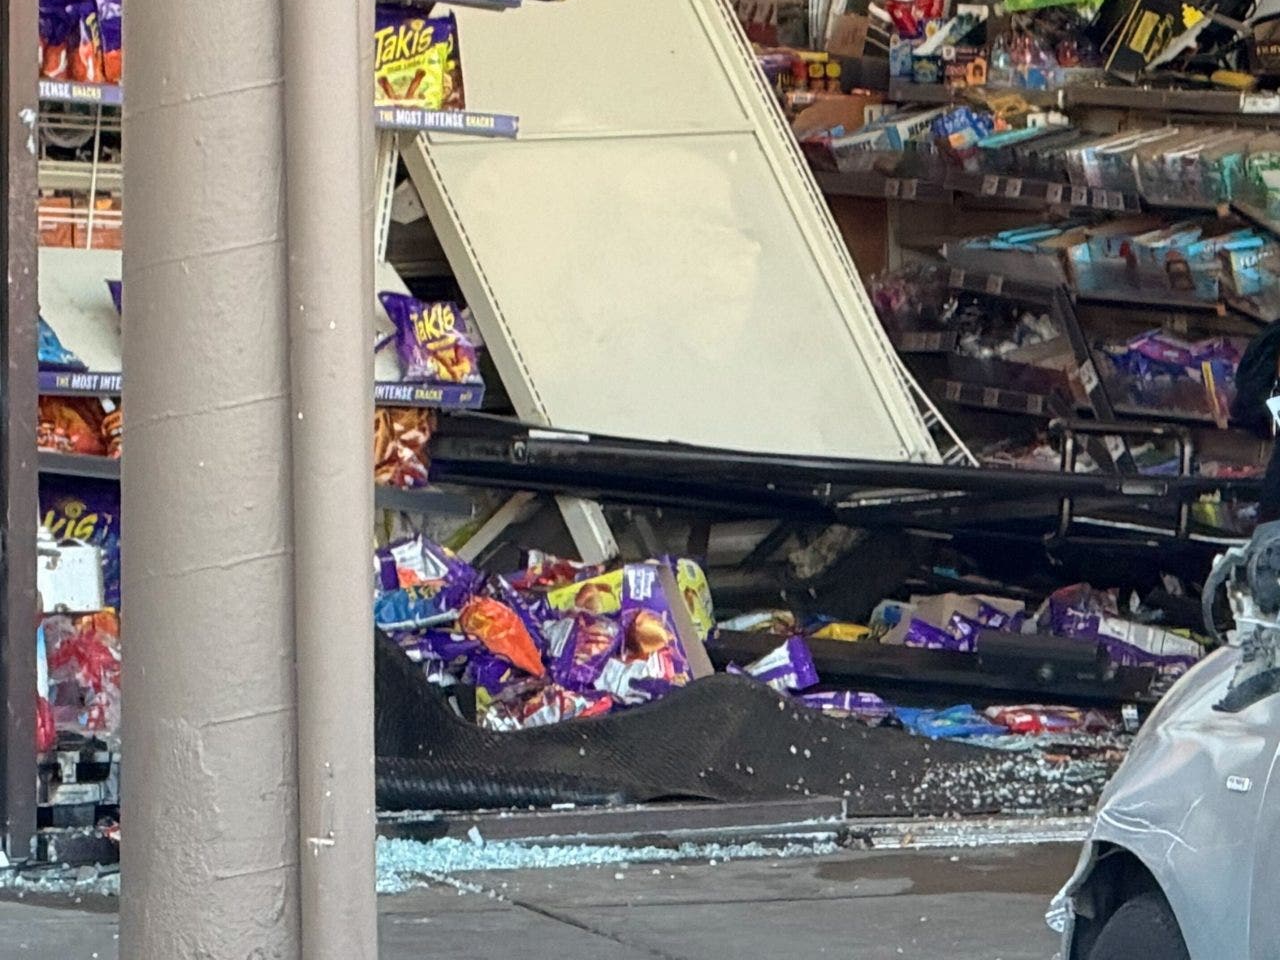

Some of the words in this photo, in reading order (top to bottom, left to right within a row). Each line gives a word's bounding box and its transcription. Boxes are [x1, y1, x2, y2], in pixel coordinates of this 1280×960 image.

[375, 19, 434, 70] Takis
[39, 81, 72, 99] TENSE
[396, 110, 422, 126] MOST
[424, 112, 464, 128] INTENSE
[71, 373, 99, 390] MOST
[99, 374, 122, 391] INTE
